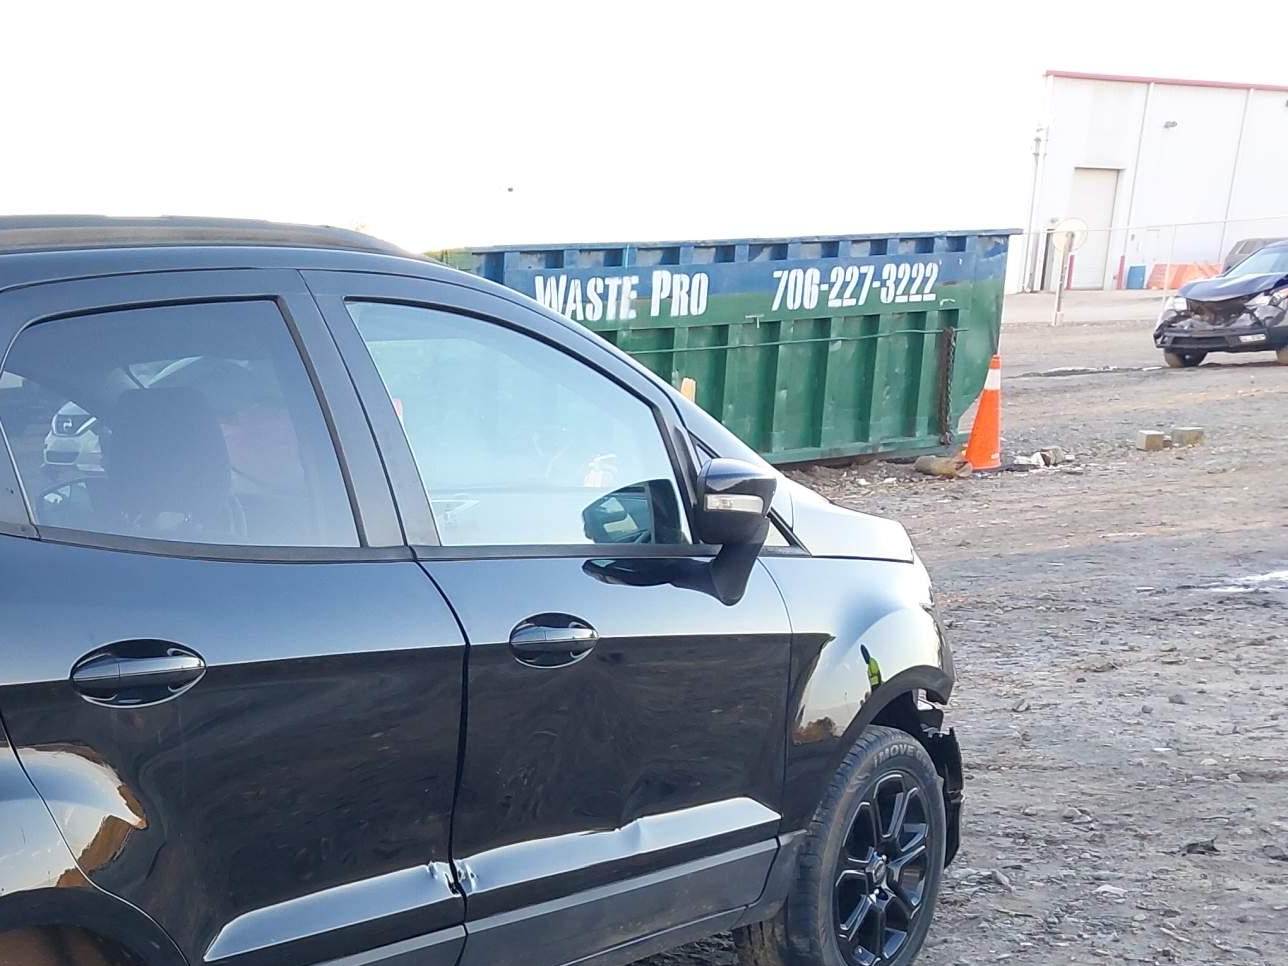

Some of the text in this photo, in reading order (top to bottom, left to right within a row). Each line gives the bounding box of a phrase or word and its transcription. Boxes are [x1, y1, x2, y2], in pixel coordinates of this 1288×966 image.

[534, 270, 709, 321] WASTE PRO
[771, 262, 939, 312] 706-227-3222
